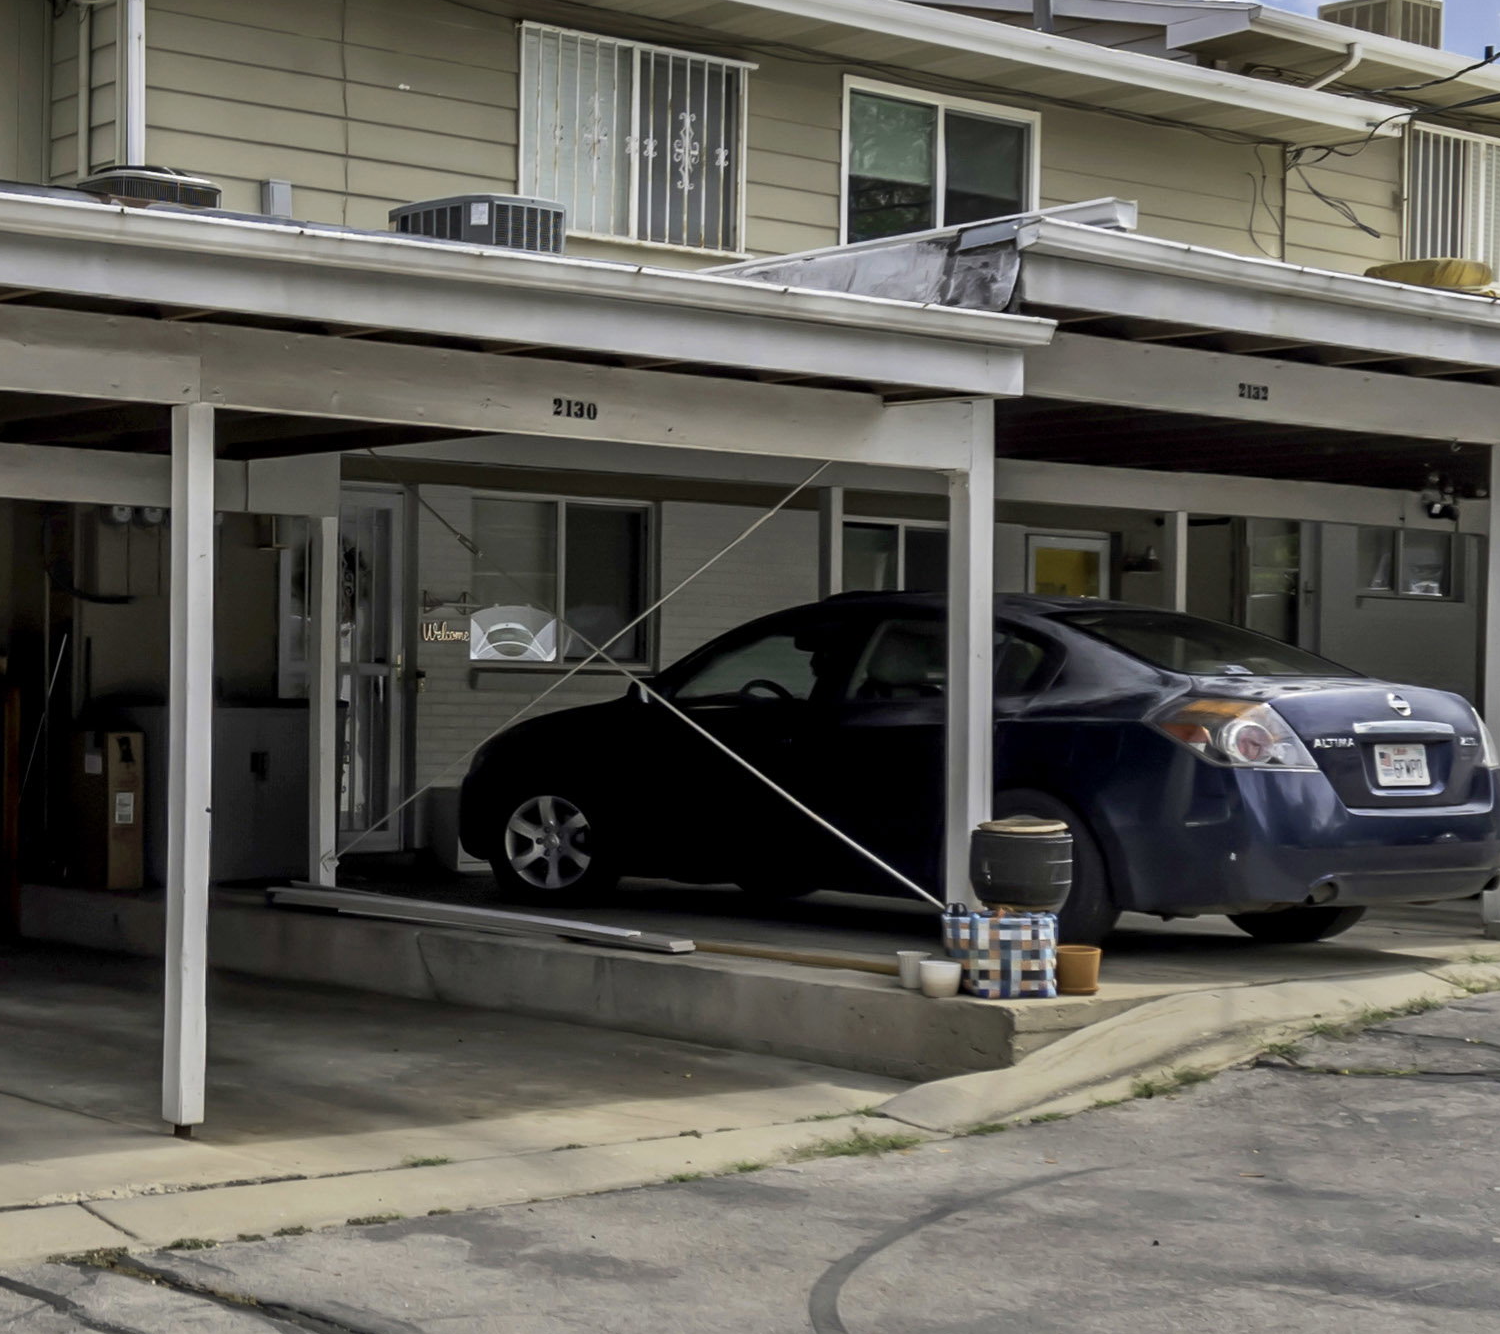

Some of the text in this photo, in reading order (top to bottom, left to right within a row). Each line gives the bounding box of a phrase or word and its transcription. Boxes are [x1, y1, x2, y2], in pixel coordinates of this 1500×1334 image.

[1238, 382, 1269, 402] 2132
[552, 397, 598, 421] 2130
[422, 620, 470, 642] Welcome
[1313, 737, 1356, 749] ALTIMA
